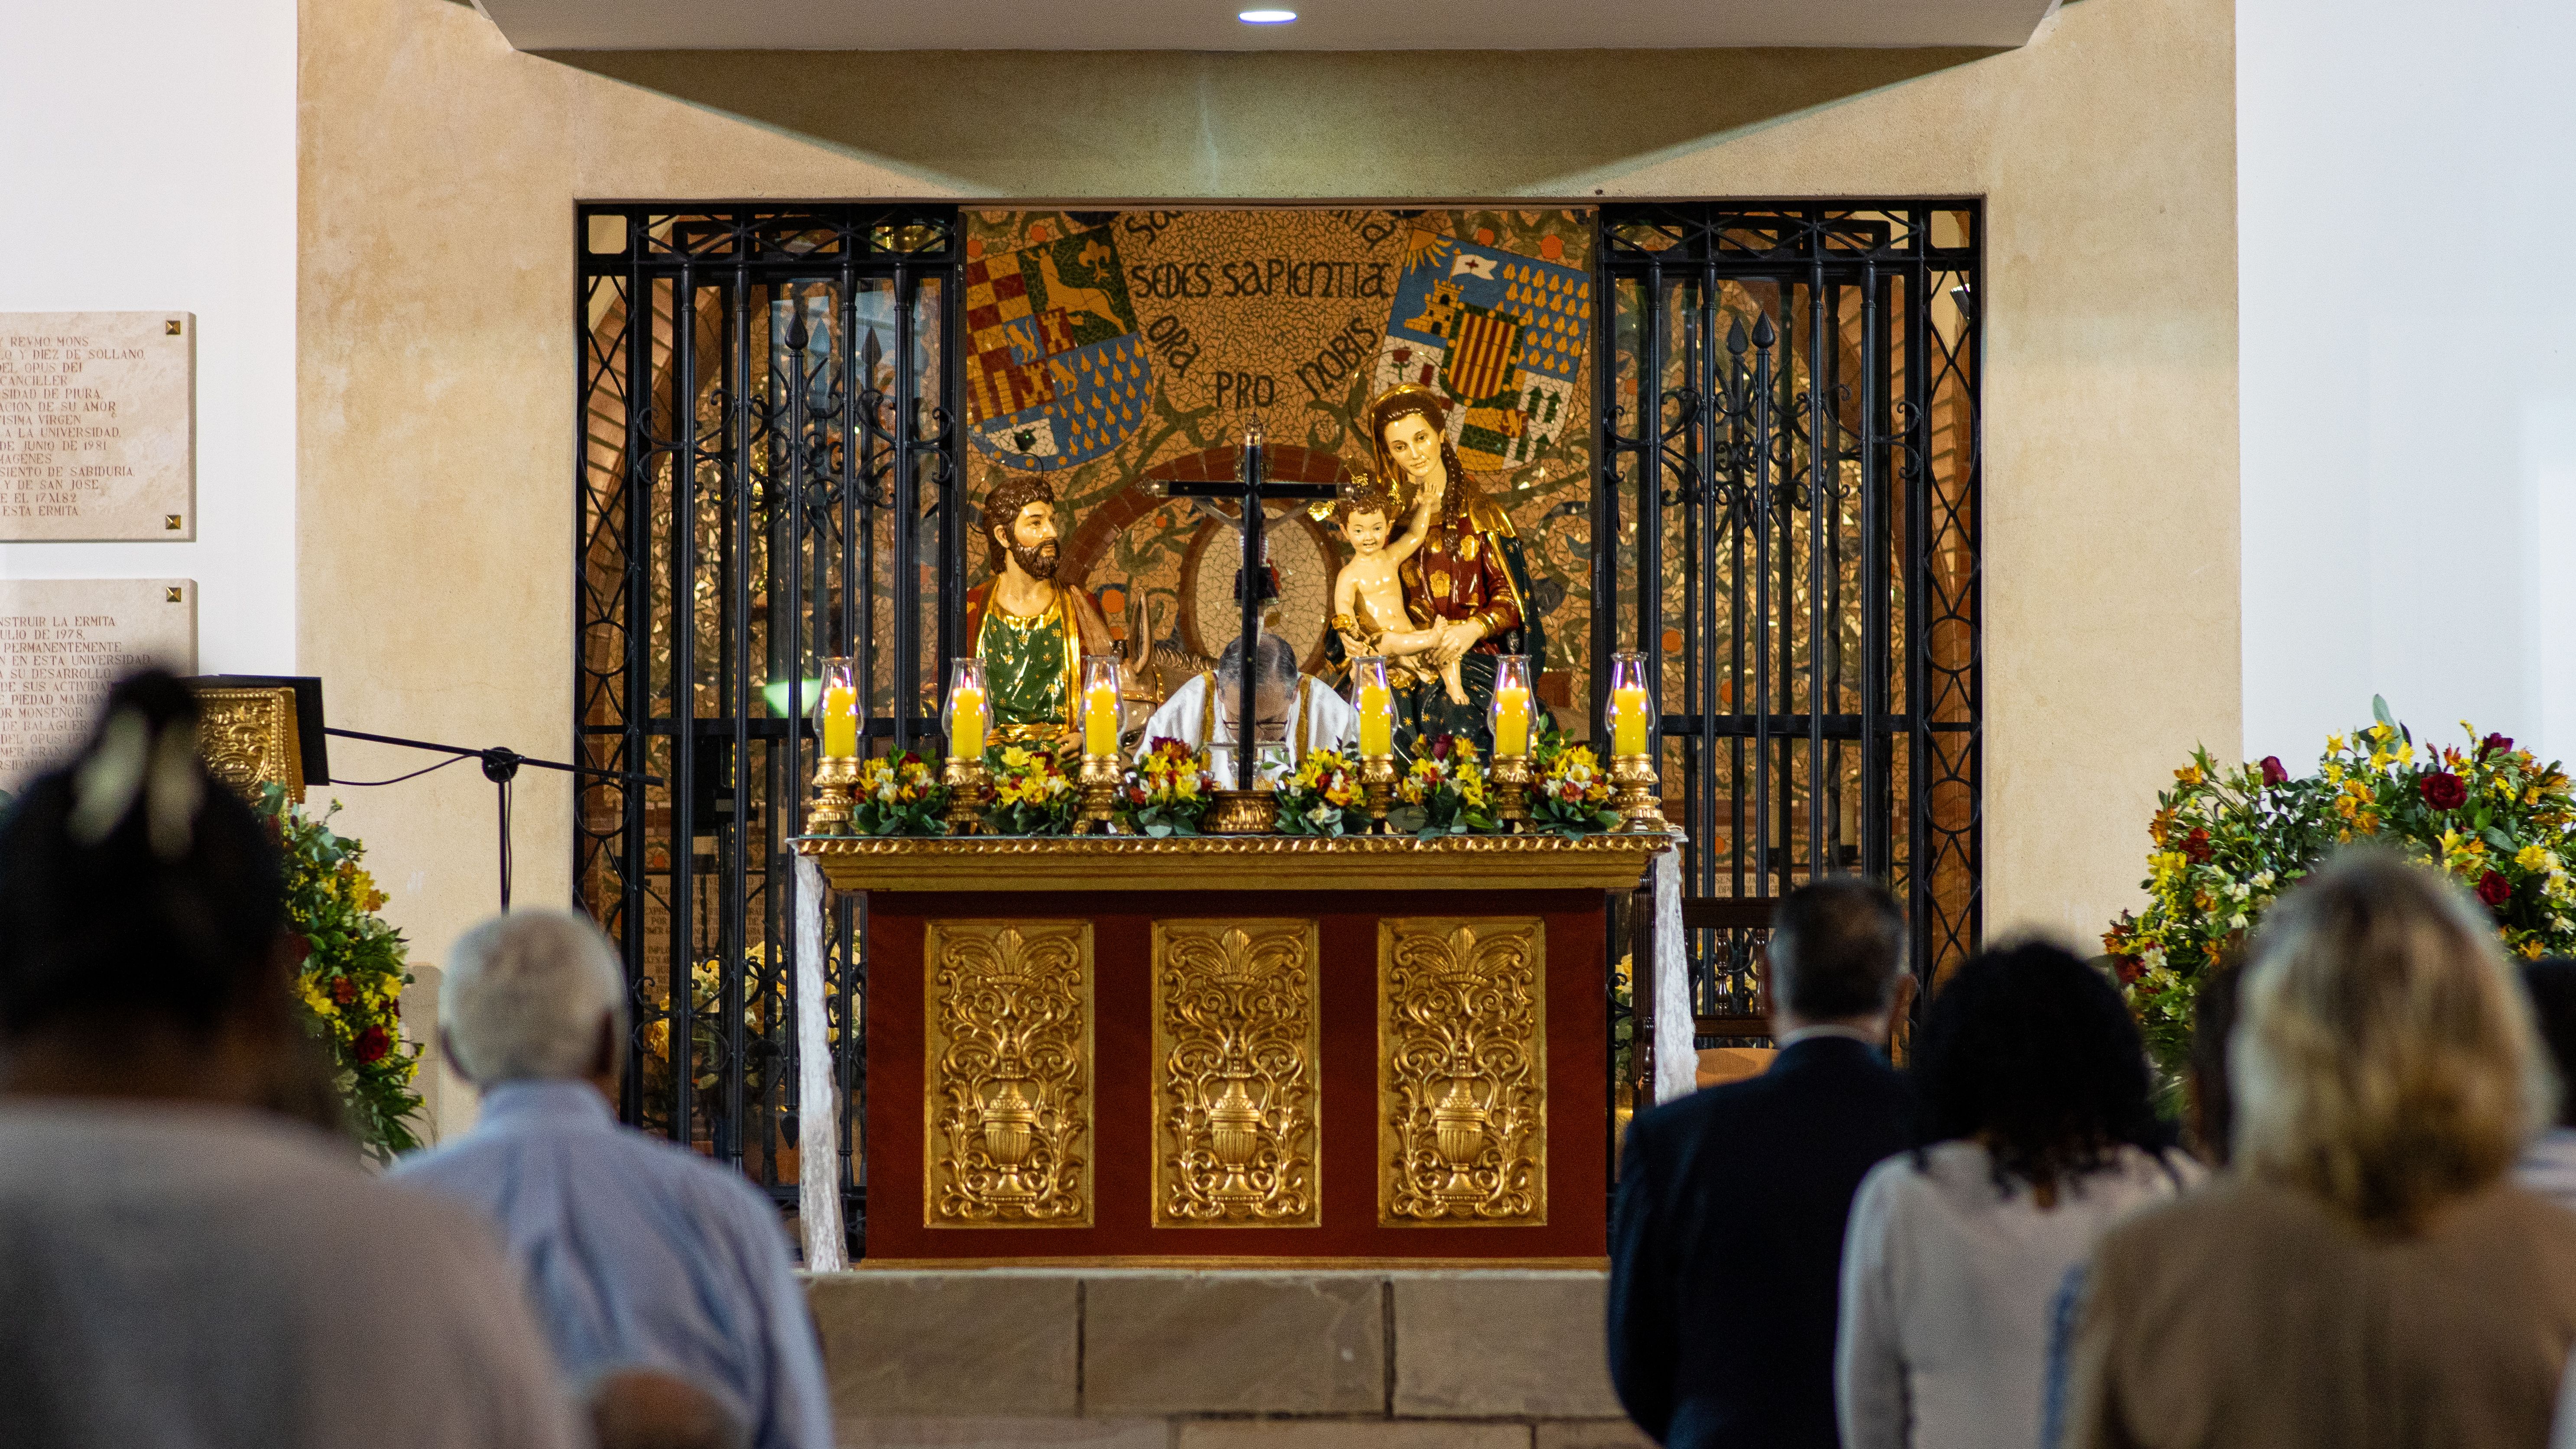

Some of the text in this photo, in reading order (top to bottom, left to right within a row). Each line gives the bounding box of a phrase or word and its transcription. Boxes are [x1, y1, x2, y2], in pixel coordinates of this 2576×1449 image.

[1131, 262, 1212, 299] SEDES
[19, 349, 25, 360] Y
[33, 349, 58, 359] DIEZ
[66, 350, 80, 360] DE
[25, 363, 55, 373] OPUS
[63, 362, 82, 373] DEI
[1217, 370, 1274, 409] PRO
[1296, 317, 1378, 402] NOBIS
[0, 375, 67, 386] CANCILLER
[0, 389, 36, 399] SIDAD
[44, 389, 58, 399] DE
[39, 402, 54, 412] DE
[61, 402, 76, 412] SU
[83, 401, 116, 412] AMOR
[0, 415, 81, 425] ISIMA VIRGEN
[4, 428, 11, 438] A
[19, 428, 33, 438] LA
[0, 441, 14, 451] DE
[23, 441, 55, 451] JUNIO
[62, 441, 77, 451] DE
[48, 467, 63, 477] DE
[4, 480, 99, 491] Y DE SAN JOSE
[15, 493, 29, 503] EL
[3, 506, 31, 516] ESTA
[53, 616, 68, 627] LA
[75, 616, 115, 626] ERMITA
[35, 629, 49, 639] DE
[4, 642, 121, 653] PERMANENTEMENTE
[13, 656, 27, 666] EN
[34, 655, 65, 666] ESTA
[11, 669, 25, 678] SU
[32, 668, 111, 679] DESARROLLO
[1, 682, 16, 692] DE
[23, 681, 46, 691] SUS
[12, 694, 53, 705] PIEDAD
[3, 720, 87, 731] DE BALAGUER
[1, 734, 23, 744] DEL
[30, 734, 61, 744] OPUS
